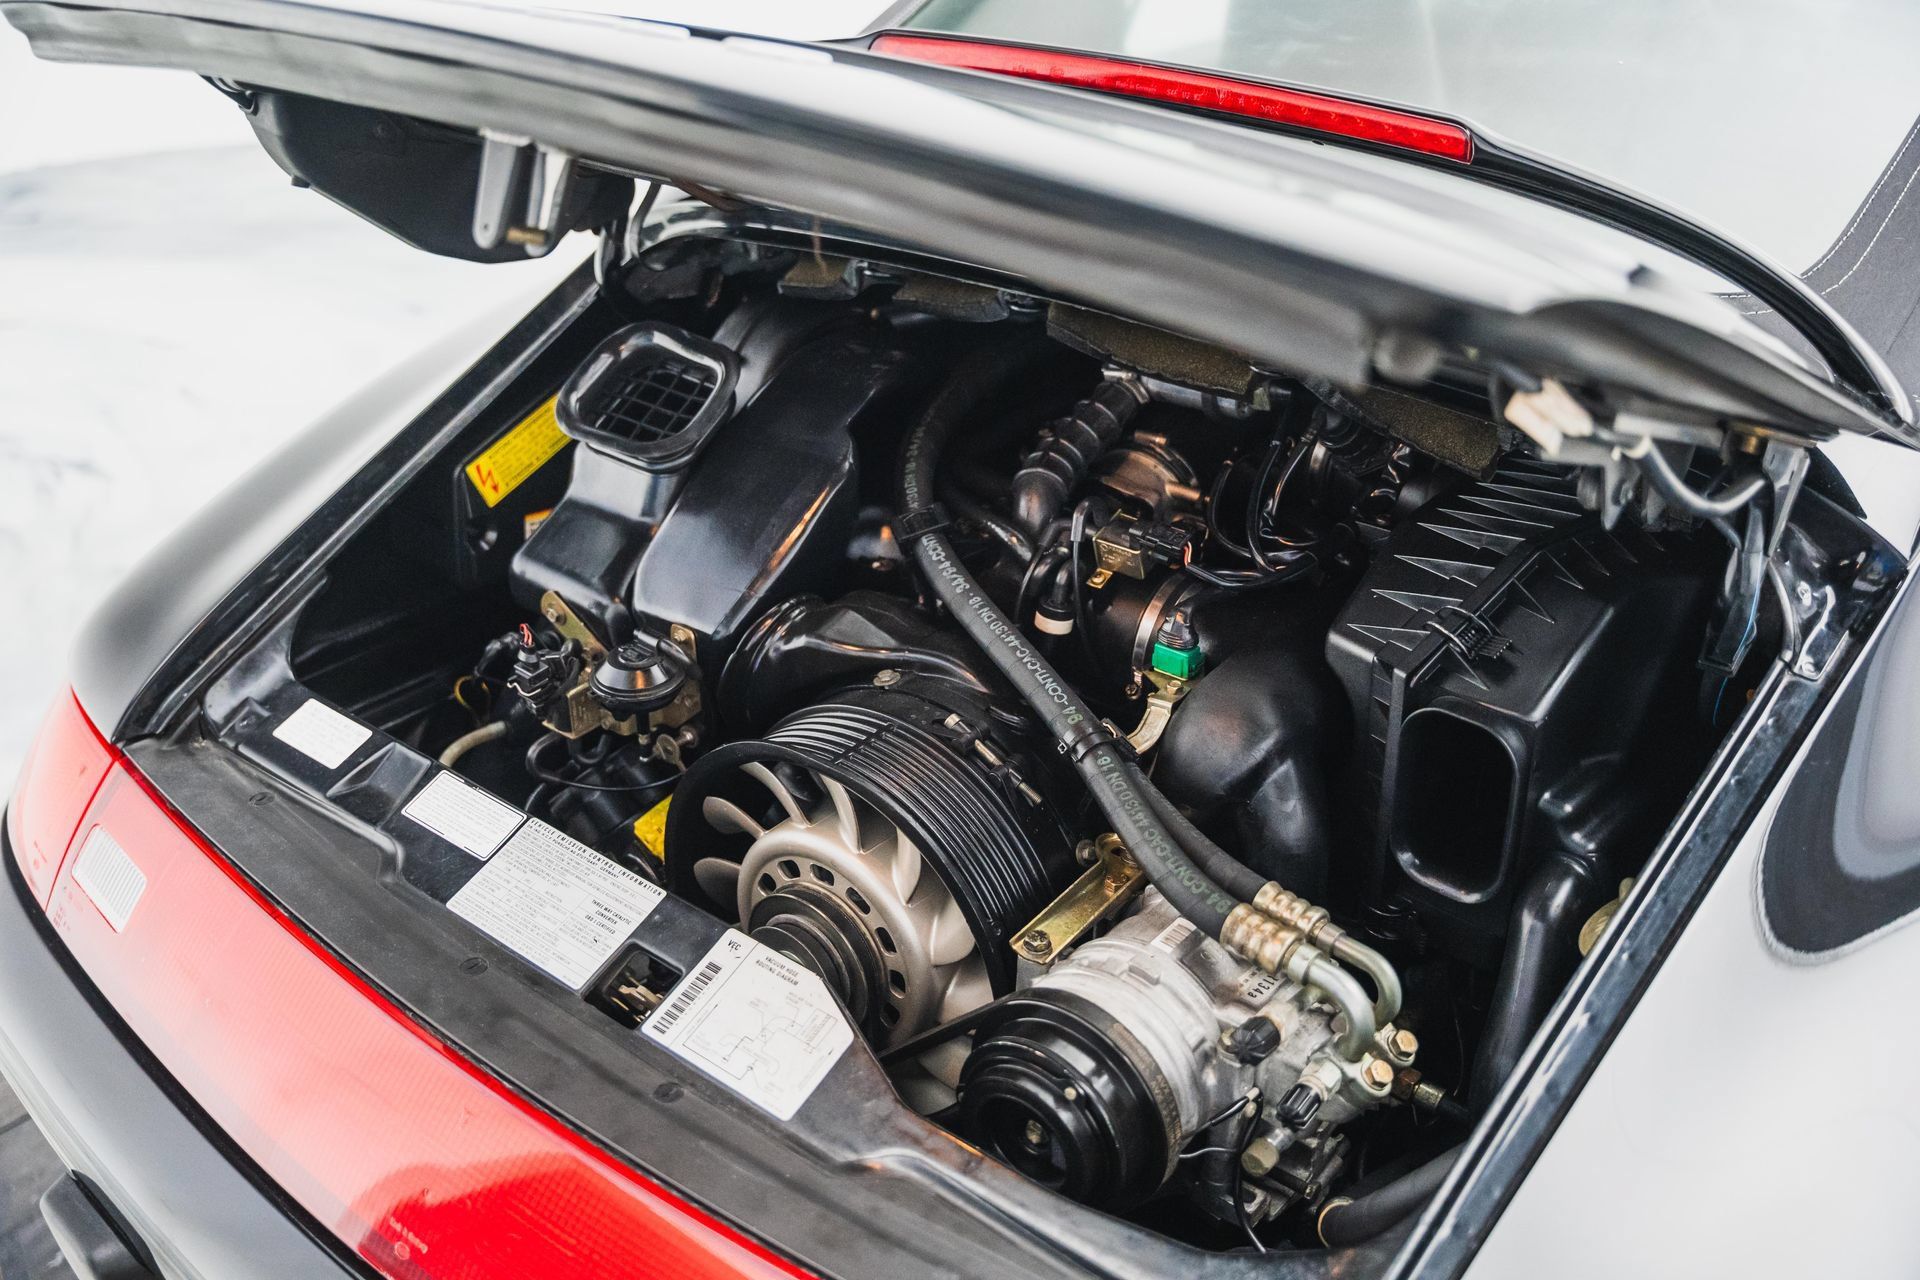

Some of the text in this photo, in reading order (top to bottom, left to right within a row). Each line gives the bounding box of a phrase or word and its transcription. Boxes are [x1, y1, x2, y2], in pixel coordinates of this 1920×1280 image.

[531, 820, 662, 897] VEHICLE EMISSION CONTROL INFORMATION
[728, 939, 742, 951] VEC
